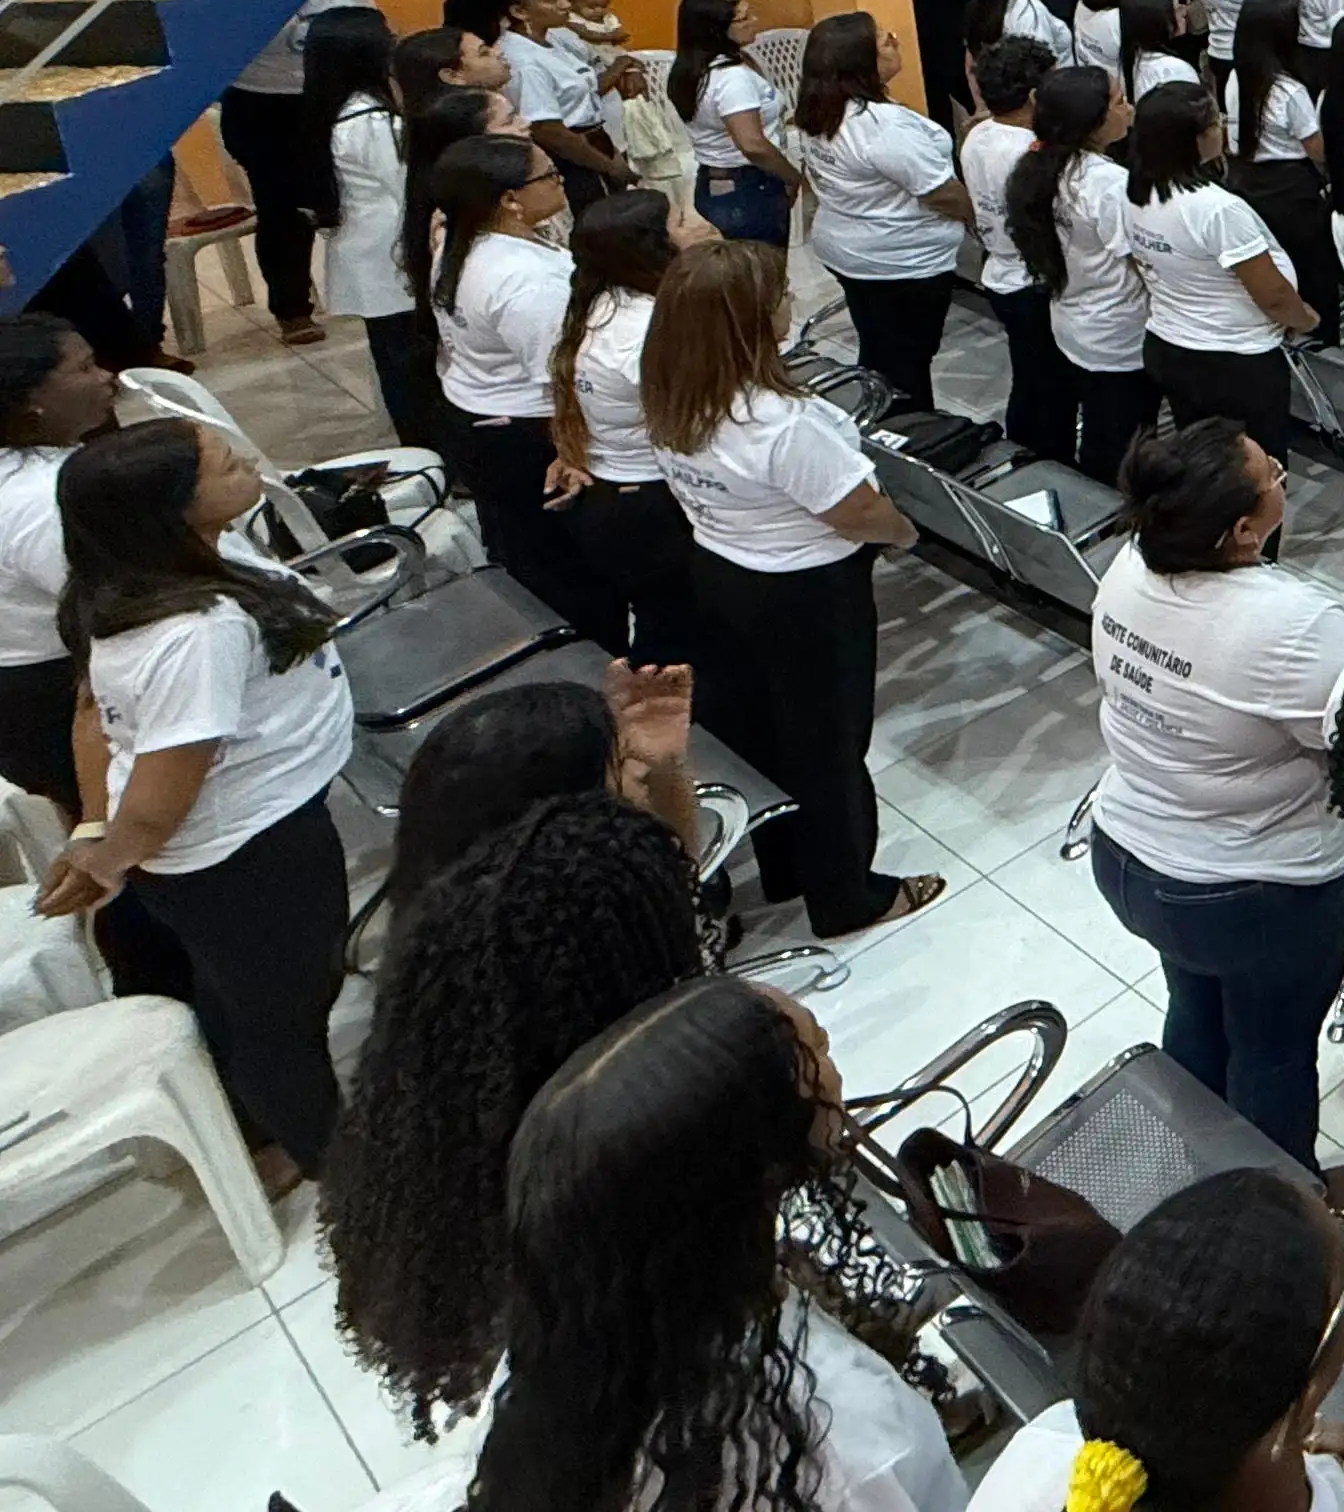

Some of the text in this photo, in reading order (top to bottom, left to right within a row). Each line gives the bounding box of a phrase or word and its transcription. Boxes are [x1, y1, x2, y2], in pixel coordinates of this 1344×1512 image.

[1109, 654, 1154, 695] DE SAÚDE
[1126, 632, 1193, 679] COMUNITÁRIO
